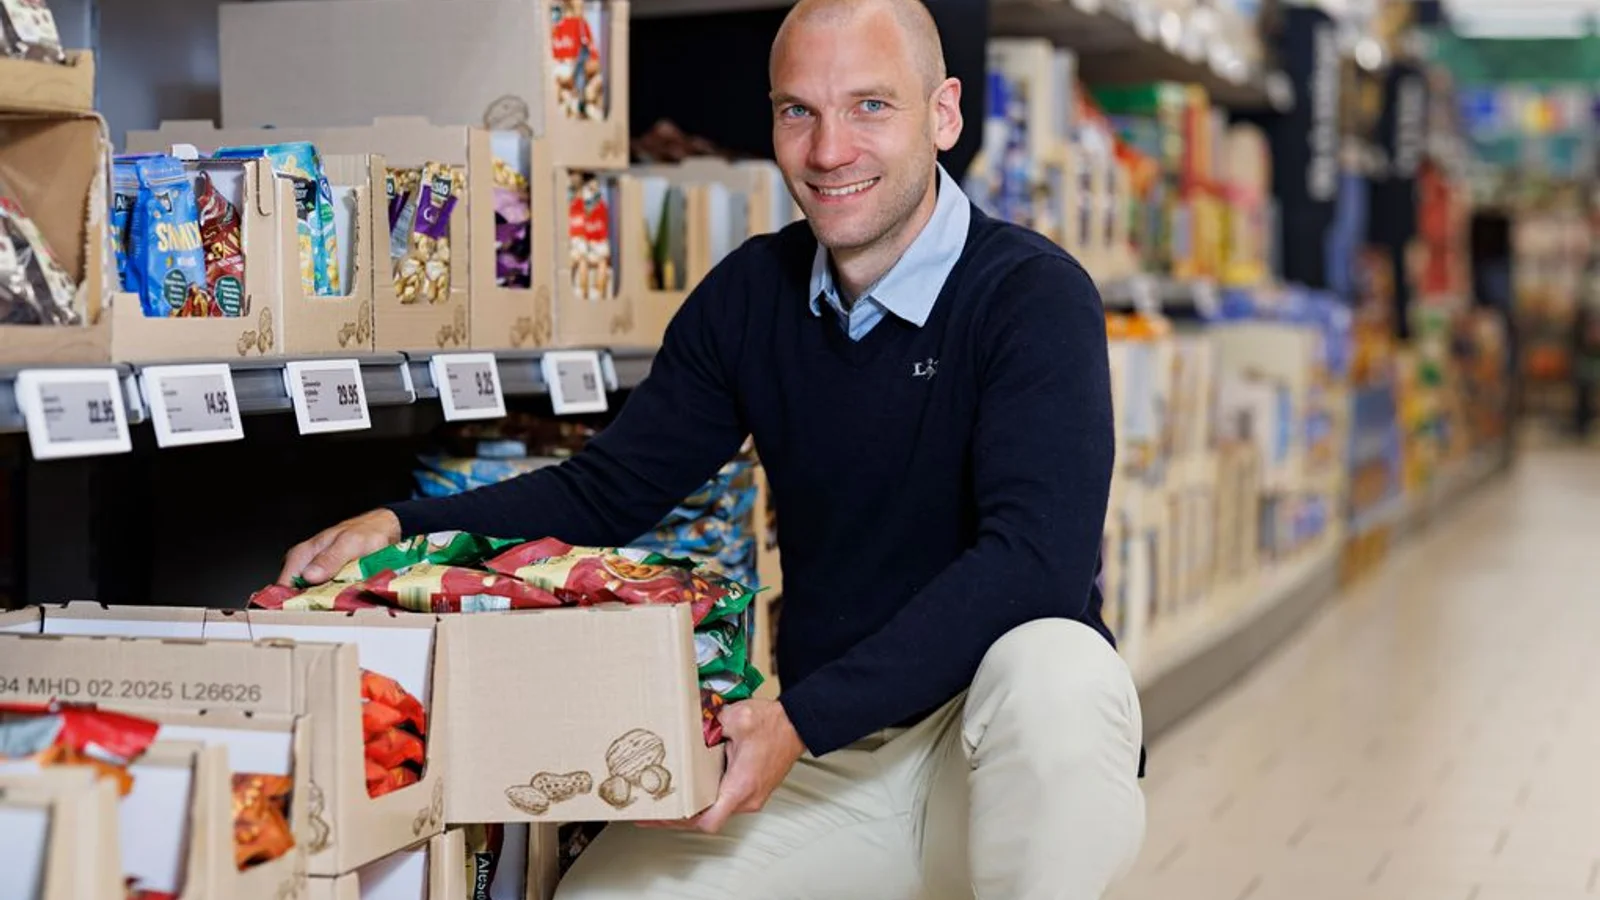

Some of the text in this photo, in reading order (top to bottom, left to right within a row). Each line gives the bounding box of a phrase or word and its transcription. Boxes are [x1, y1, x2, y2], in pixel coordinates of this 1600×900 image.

[204, 391, 230, 415] 14.95
[337, 384, 359, 406] 29.95
[27, 677, 81, 697] MHD
[87, 679, 174, 700] 02.2025
[181, 682, 262, 702] L26626
